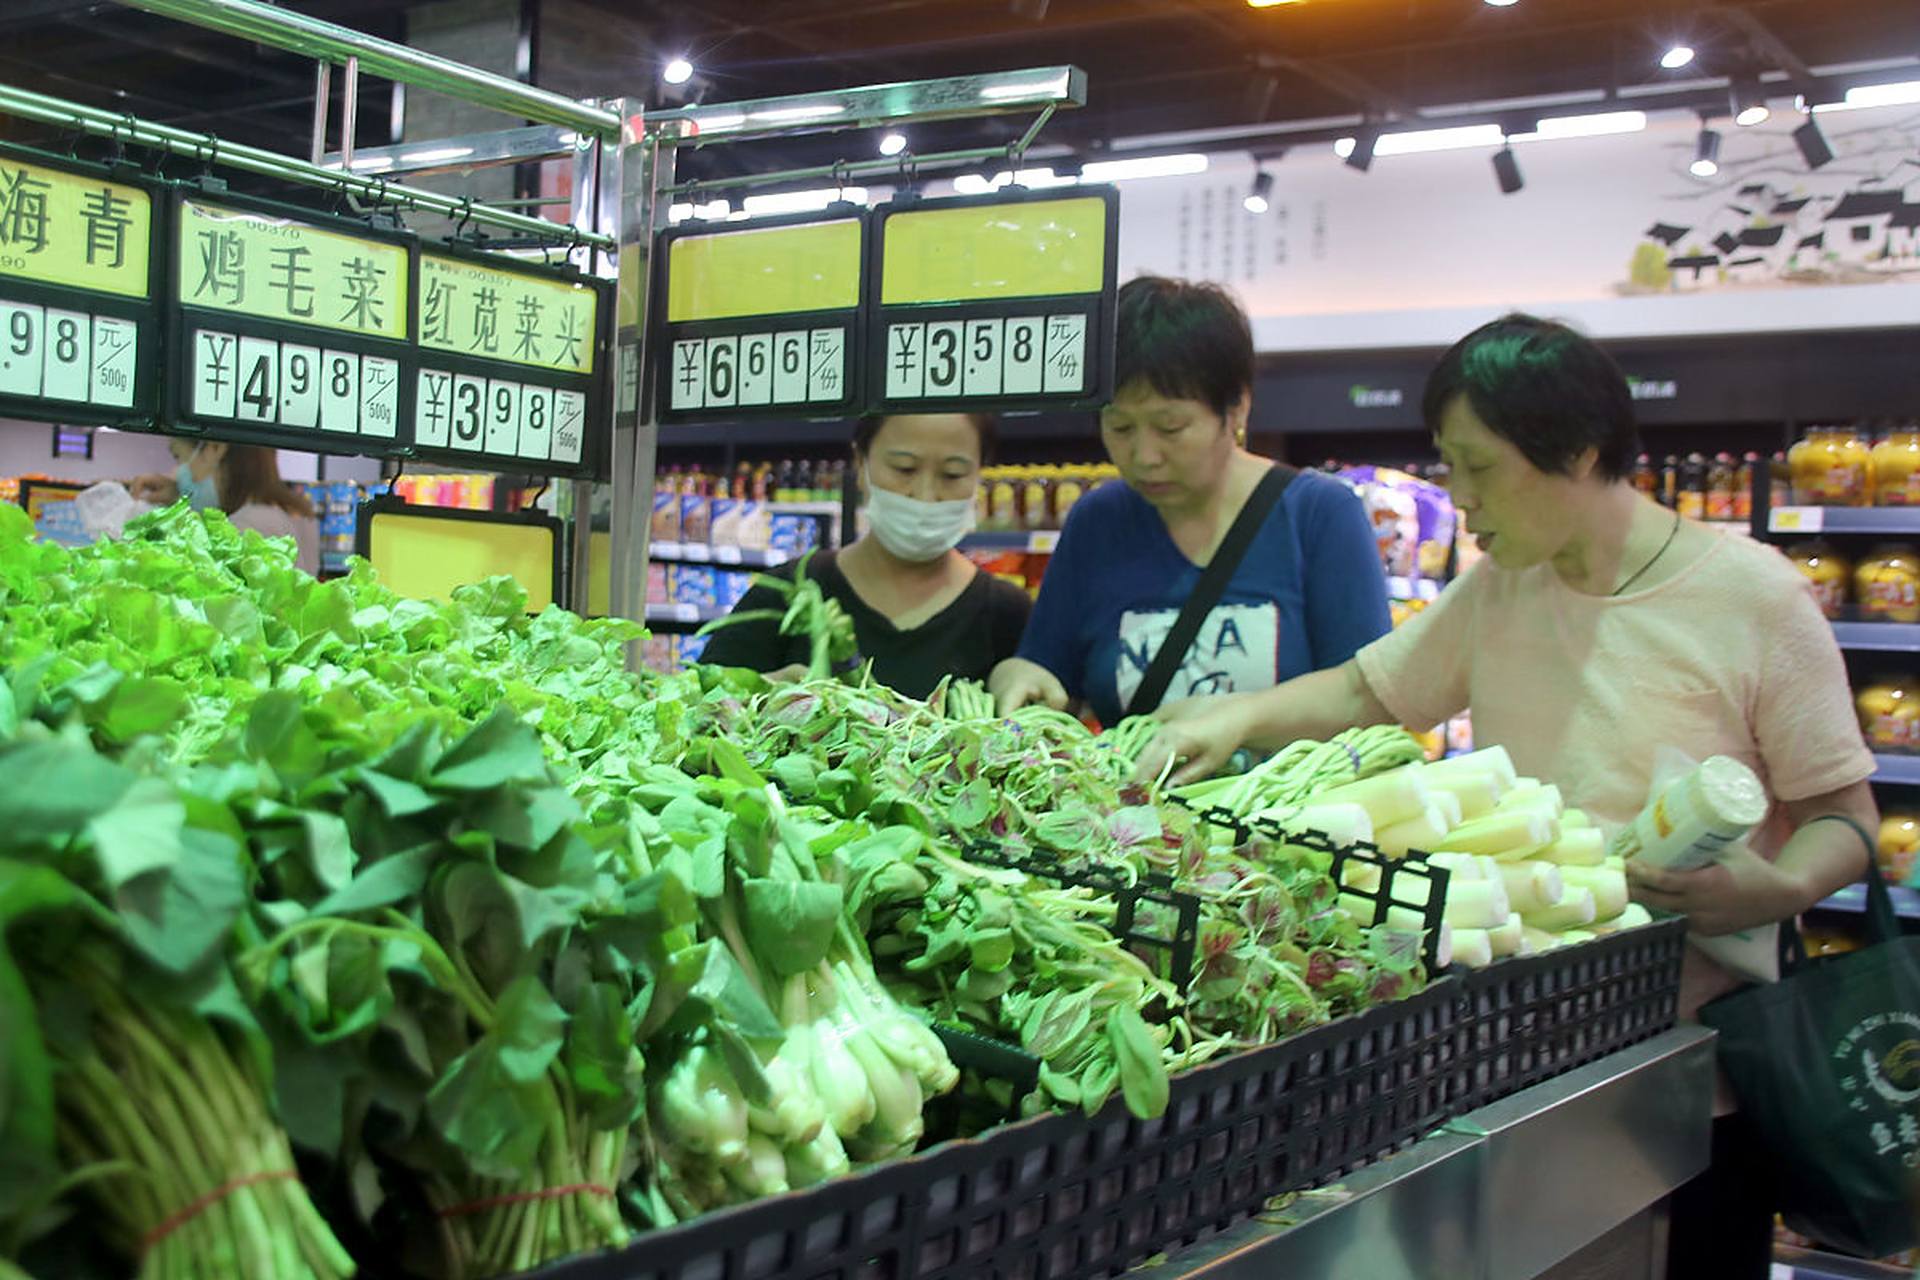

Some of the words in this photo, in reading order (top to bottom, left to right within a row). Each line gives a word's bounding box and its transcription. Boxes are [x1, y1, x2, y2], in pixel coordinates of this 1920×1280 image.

[0, 169, 134, 268] 海青
[194, 229, 387, 329] 鸡毛菜
[422, 277, 587, 368] 红苋菜头
